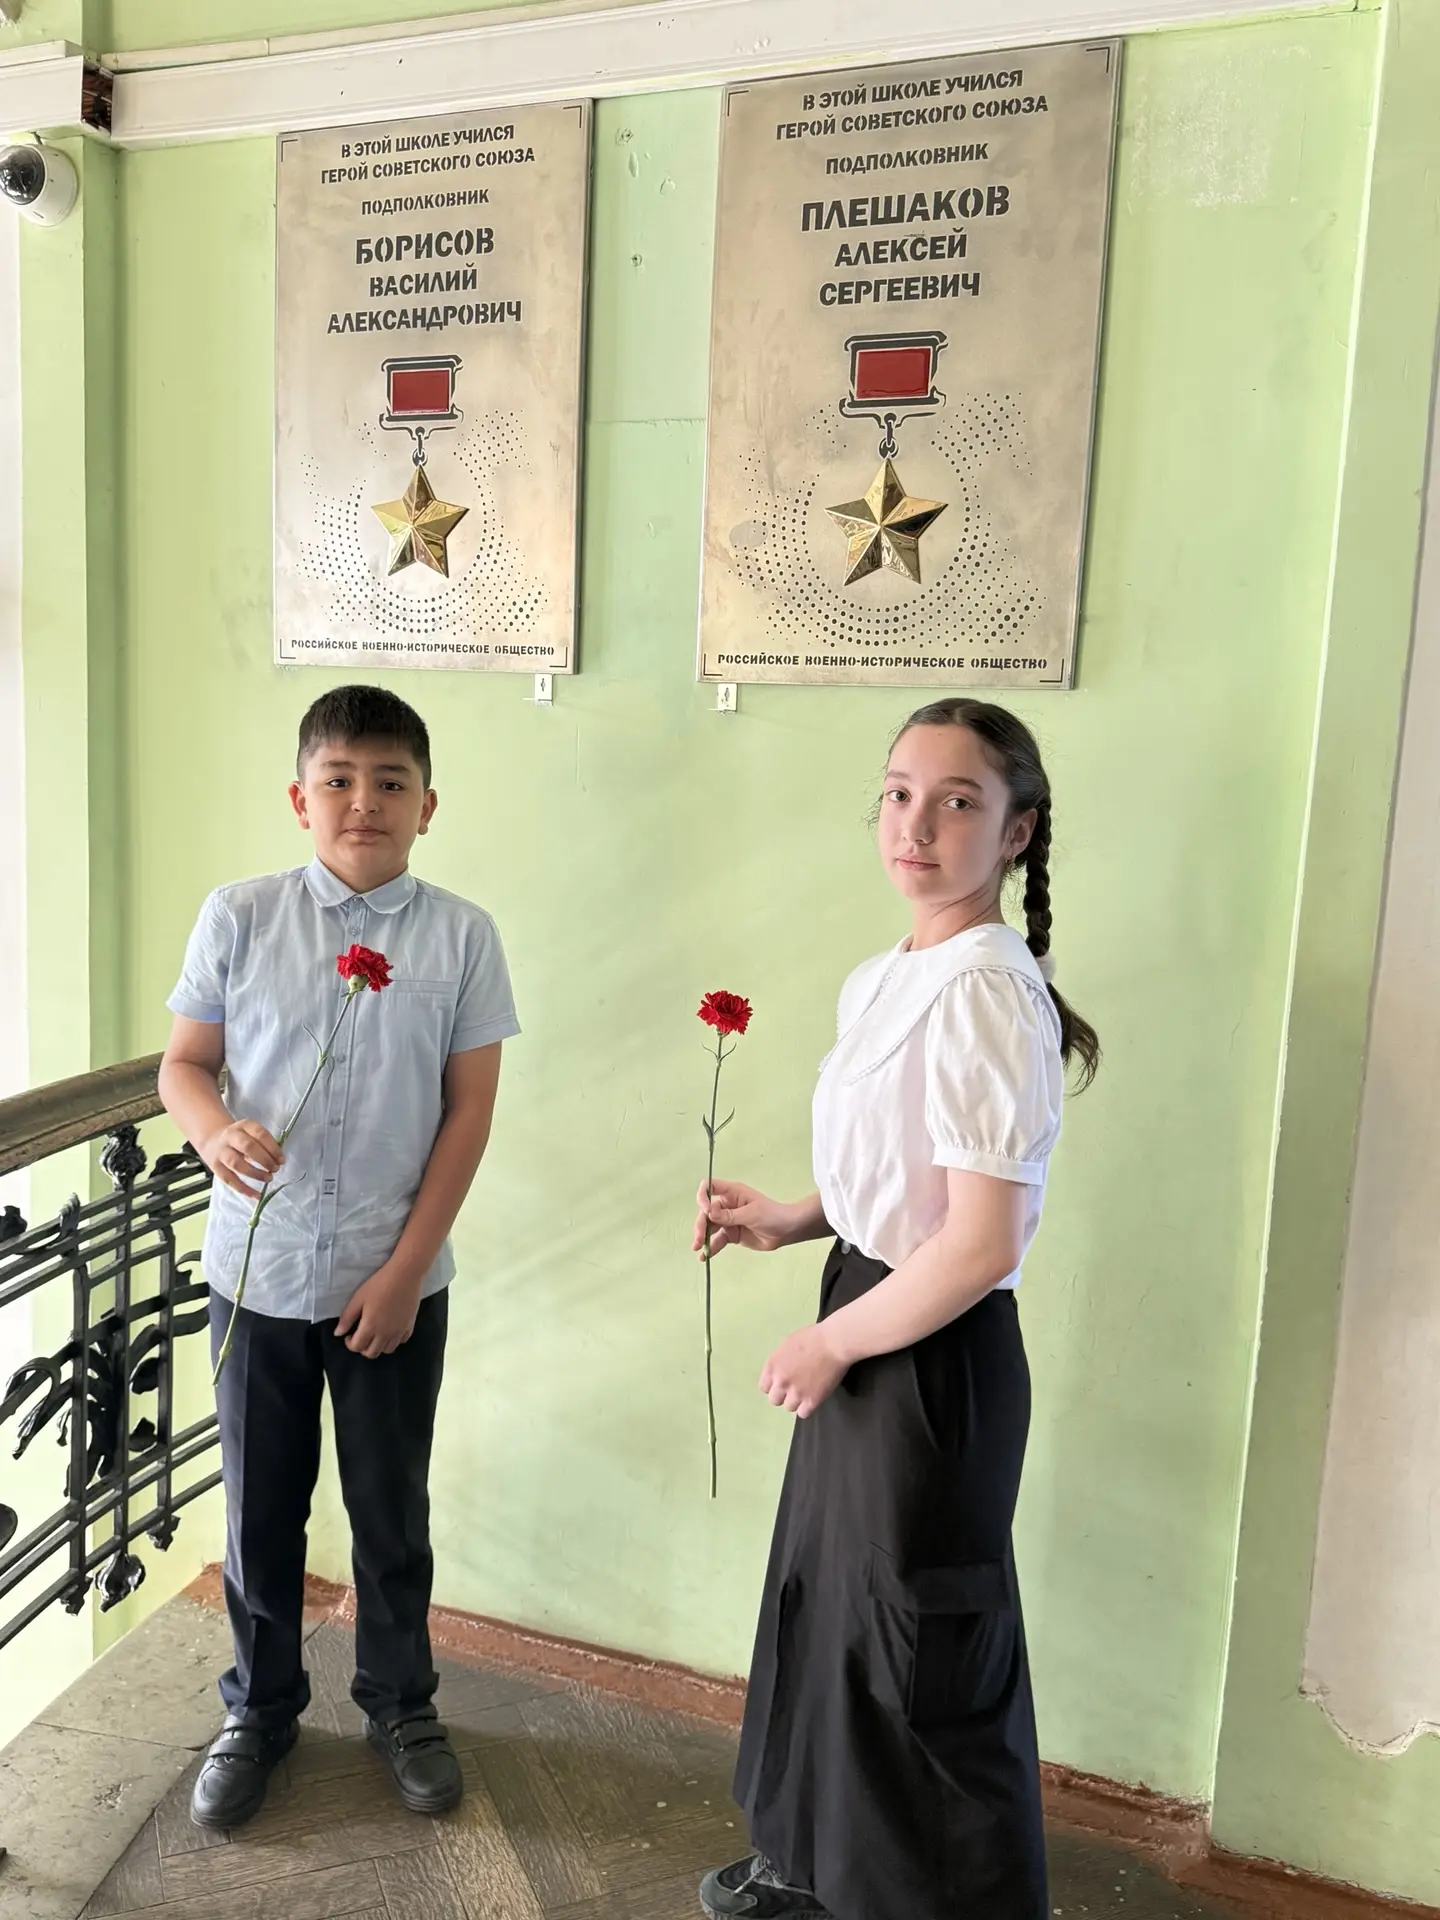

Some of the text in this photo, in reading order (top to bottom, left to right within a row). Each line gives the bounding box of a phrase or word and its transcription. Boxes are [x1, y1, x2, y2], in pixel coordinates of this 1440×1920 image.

[803, 70, 1023, 111] В ЭТОЙ ШКОЛЕ УЧИЛСЯ
[776, 95, 1048, 140] ГЕРОЙ СОВЕТСКОГО СОЮЗА
[341, 124, 515, 158] В ЭТОЙ ШКОЛЕ УЧИЛСЯ
[321, 147, 535, 184] ГЕРОЙ СОВЕТСКОГО СОЮЗА
[826, 143, 988, 175] ПОДПОЛКОВНИК
[361, 189, 489, 216] ПОДПОЛКОВНИК
[801, 185, 1009, 231] ПЛЕШАКОВ
[356, 227, 494, 264] БОРИСОВ
[834, 227, 967, 267] АЛЕКСЕЙ
[369, 262, 477, 297] ВАСИЛИЙ
[819, 273, 980, 306] СЕРГЕЕВИЧ
[327, 301, 522, 334] АЛЕКСАНДРОВИЧ
[291, 638, 555, 656] РОССИЙСКОЕ ВОЕННО-ИСТОРИЧЕСКОЕ ОБЩЕСТВО
[718, 652, 1047, 671] РОССИЙСКОЕ ВОЕННО-ИСТОРИЧЕСКОЕ ОБЩЕСТВО
